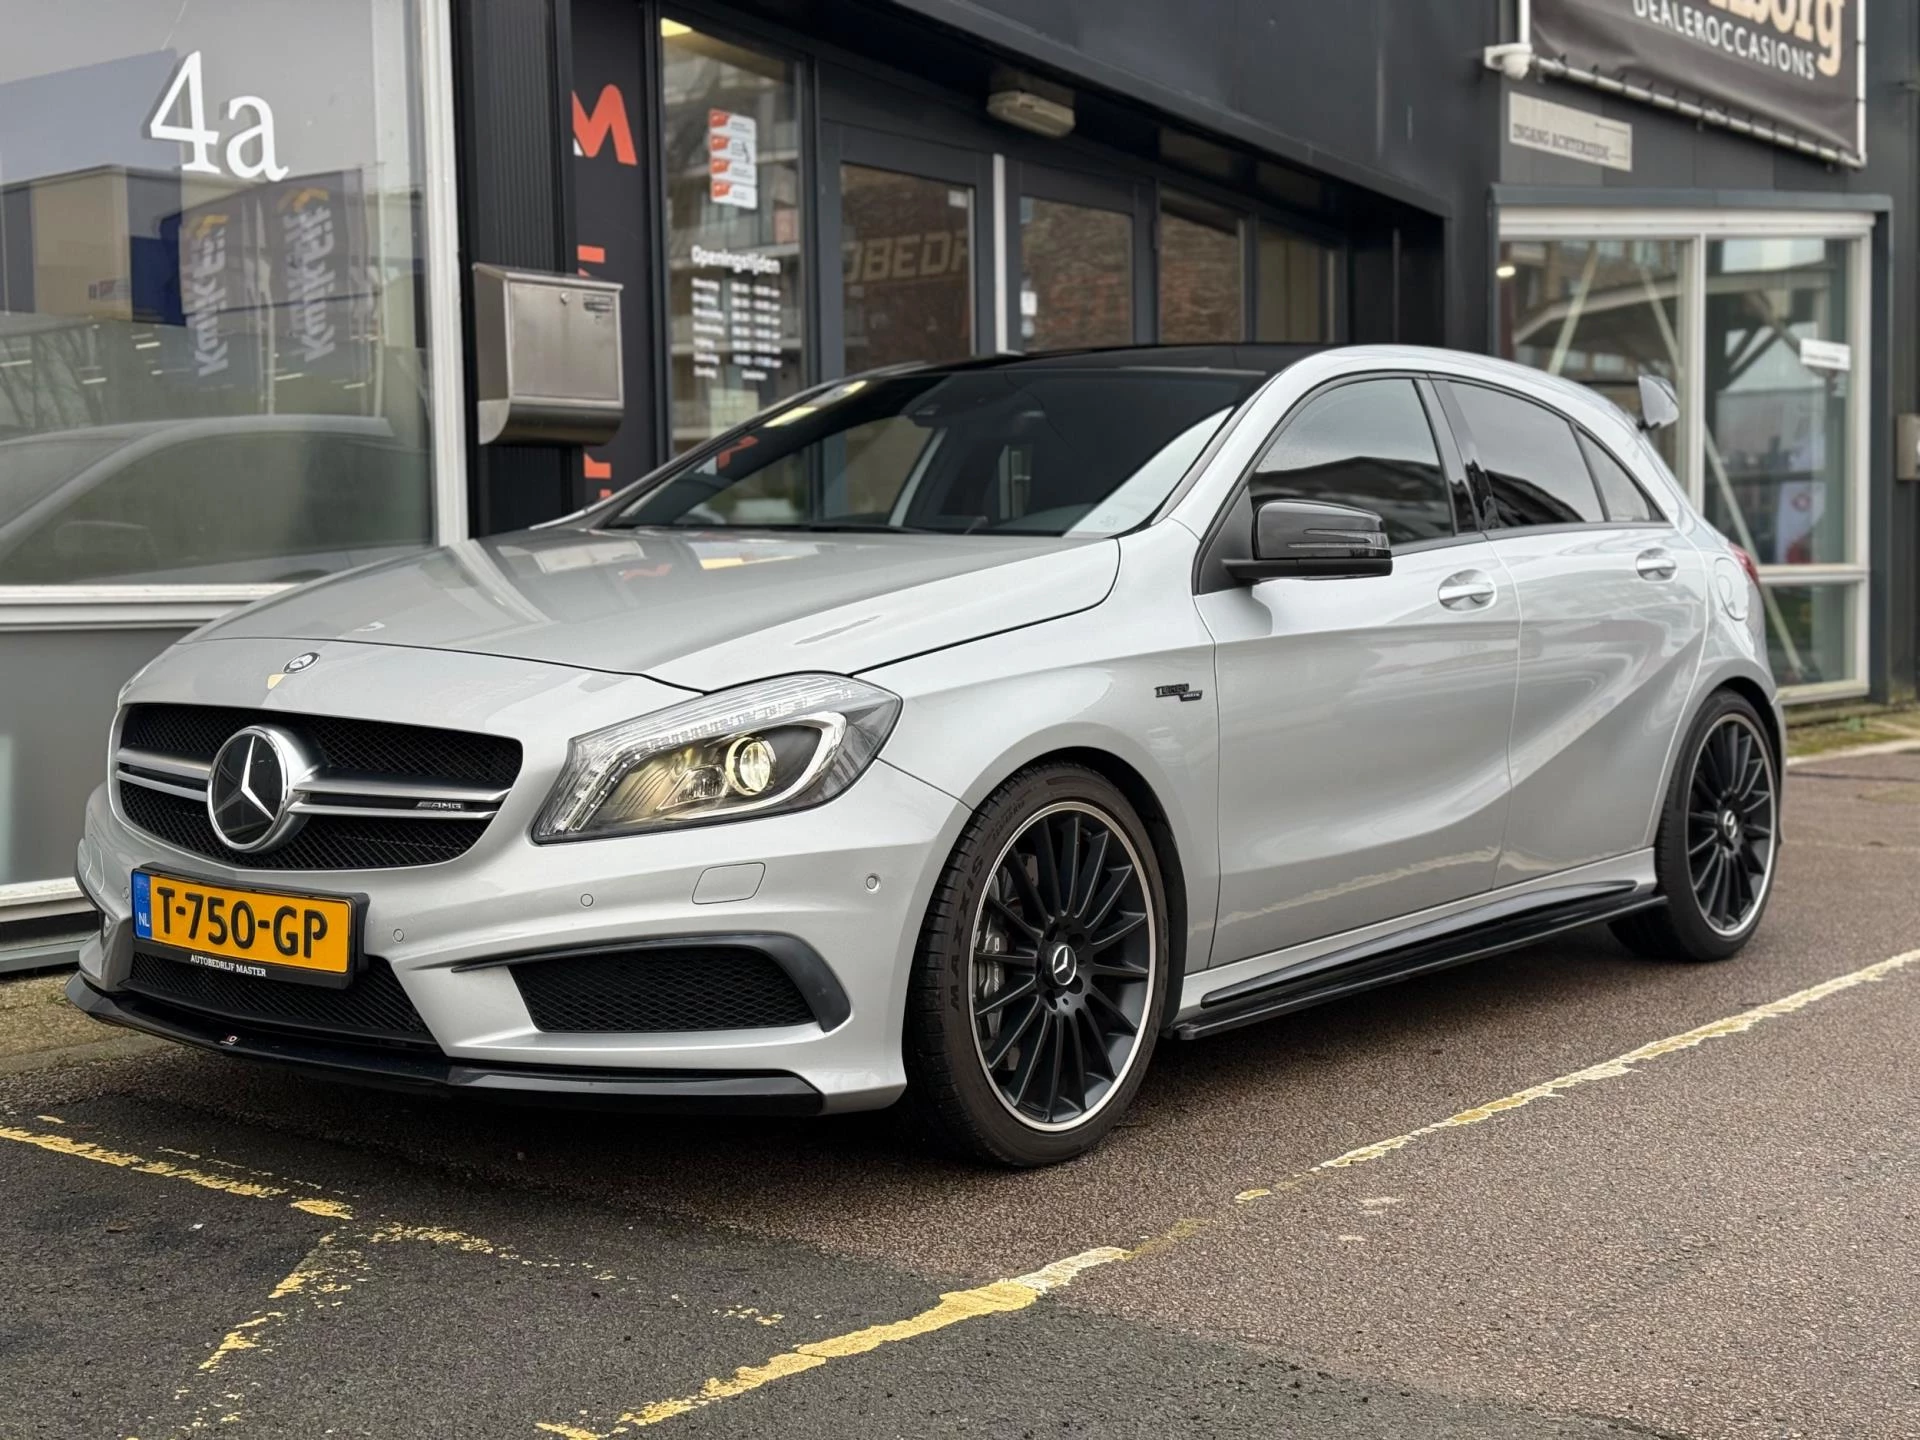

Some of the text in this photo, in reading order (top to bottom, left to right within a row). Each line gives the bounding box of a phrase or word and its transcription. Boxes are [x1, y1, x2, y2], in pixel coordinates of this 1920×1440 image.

[1633, 0, 1815, 80] DEALEROCCASIONS
[150, 50, 289, 182] 4a
[692, 245, 781, 275] Openingstijden
[138, 886, 329, 959] NL T-750-GP
[951, 854, 984, 1012] MAXXIS
[190, 954, 267, 977] AUTOBEDRIJF MASTER
